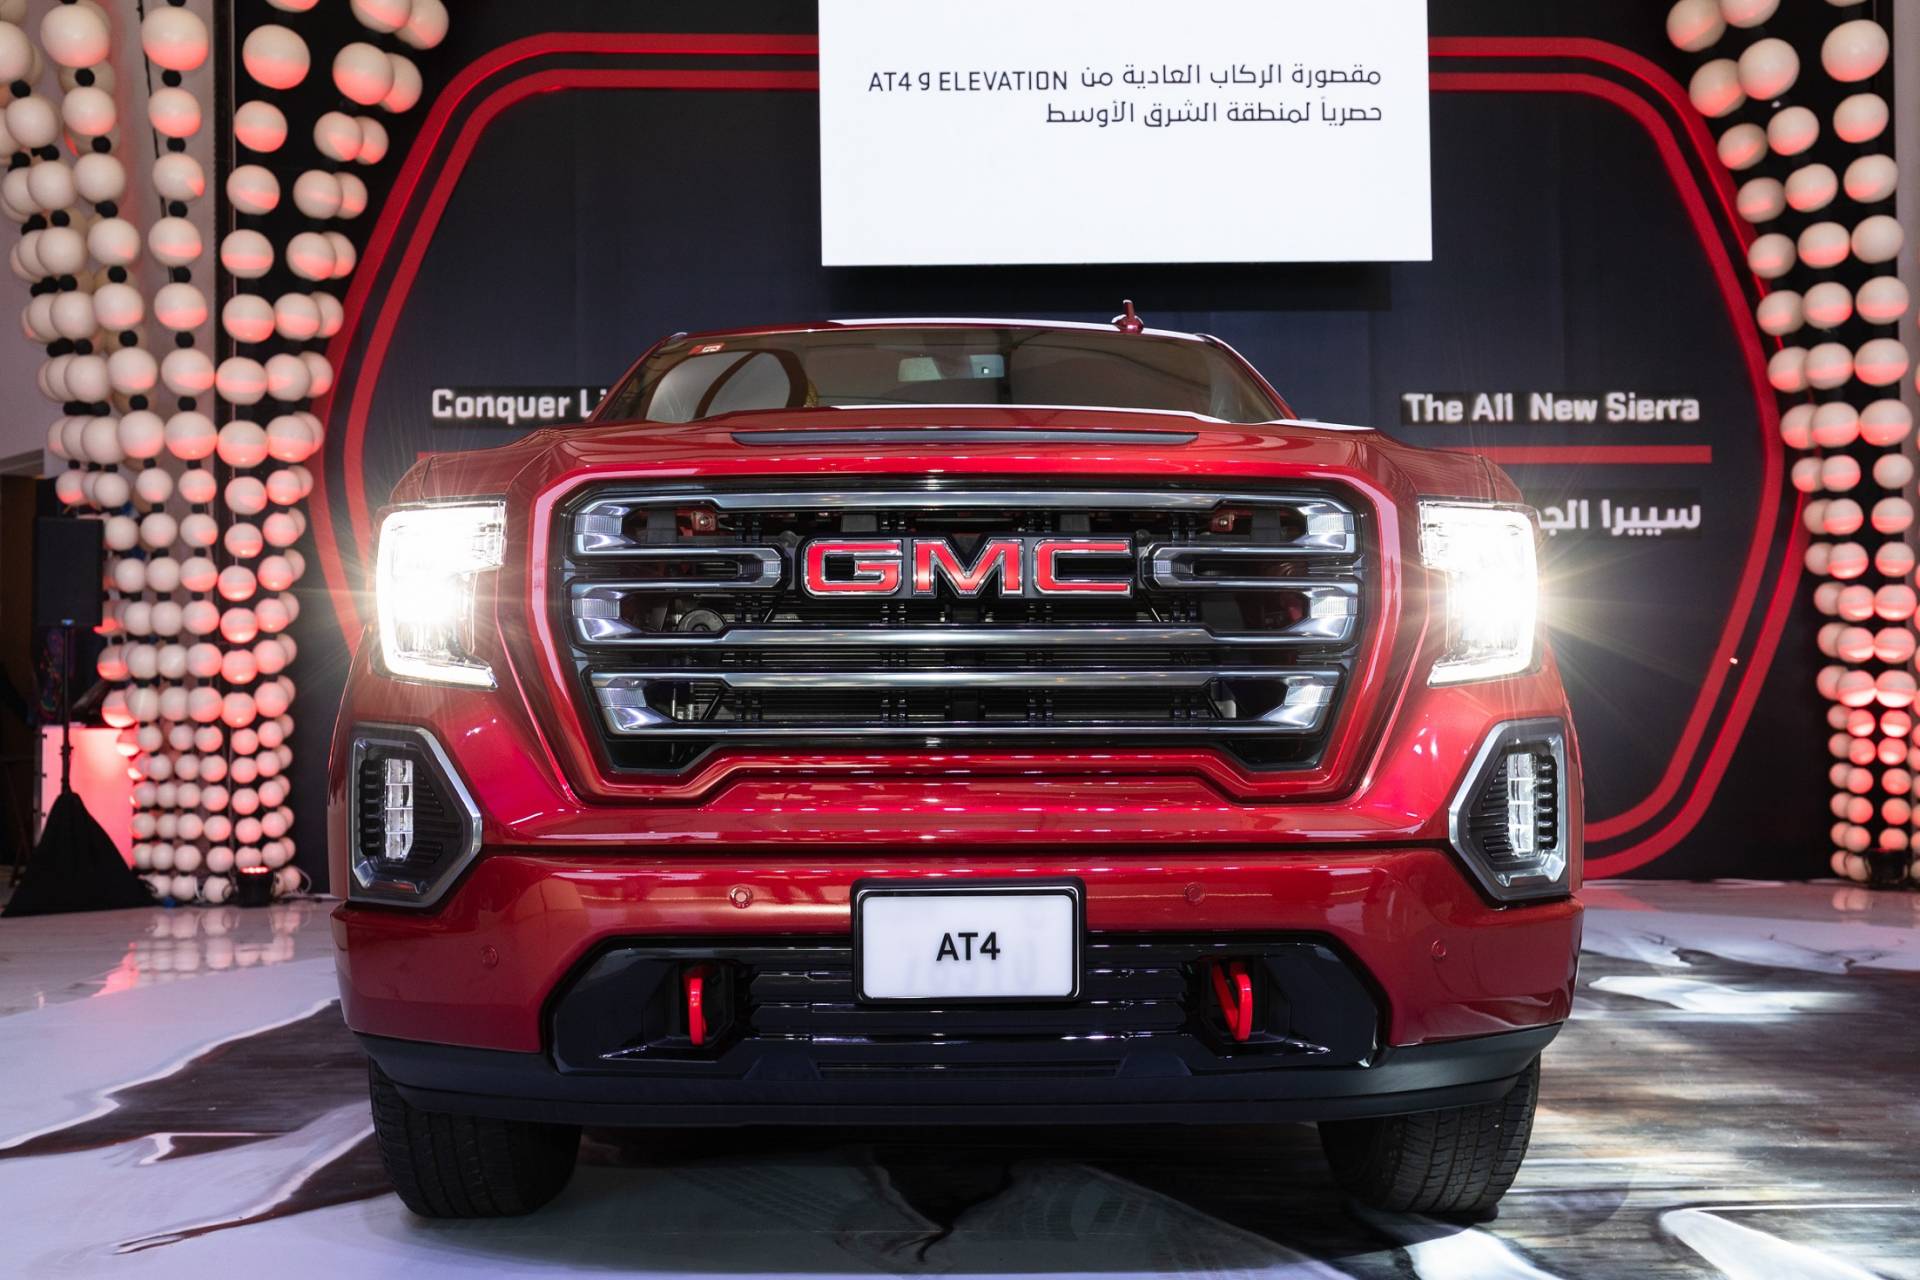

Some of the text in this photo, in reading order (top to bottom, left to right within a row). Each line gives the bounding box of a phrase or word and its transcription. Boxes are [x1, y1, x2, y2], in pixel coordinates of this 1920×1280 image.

[868, 71, 912, 92] AT4
[939, 71, 1067, 91] ELEVATION
[1081, 67, 1113, 88] من
[1122, 64, 1201, 89] العادية
[1210, 64, 1283, 89] الركاب
[1291, 63, 1382, 89] مقصورة
[1045, 100, 1134, 128] الأوسط
[1143, 99, 1217, 128] الشرق
[1226, 101, 1311, 124] لمنطقة
[431, 388, 571, 426] Conquer
[1402, 391, 1701, 423] The All New Sierra
[1600, 499, 1702, 537] سييرا
[801, 536, 1134, 598] GMC
[935, 931, 1001, 962] AT4
